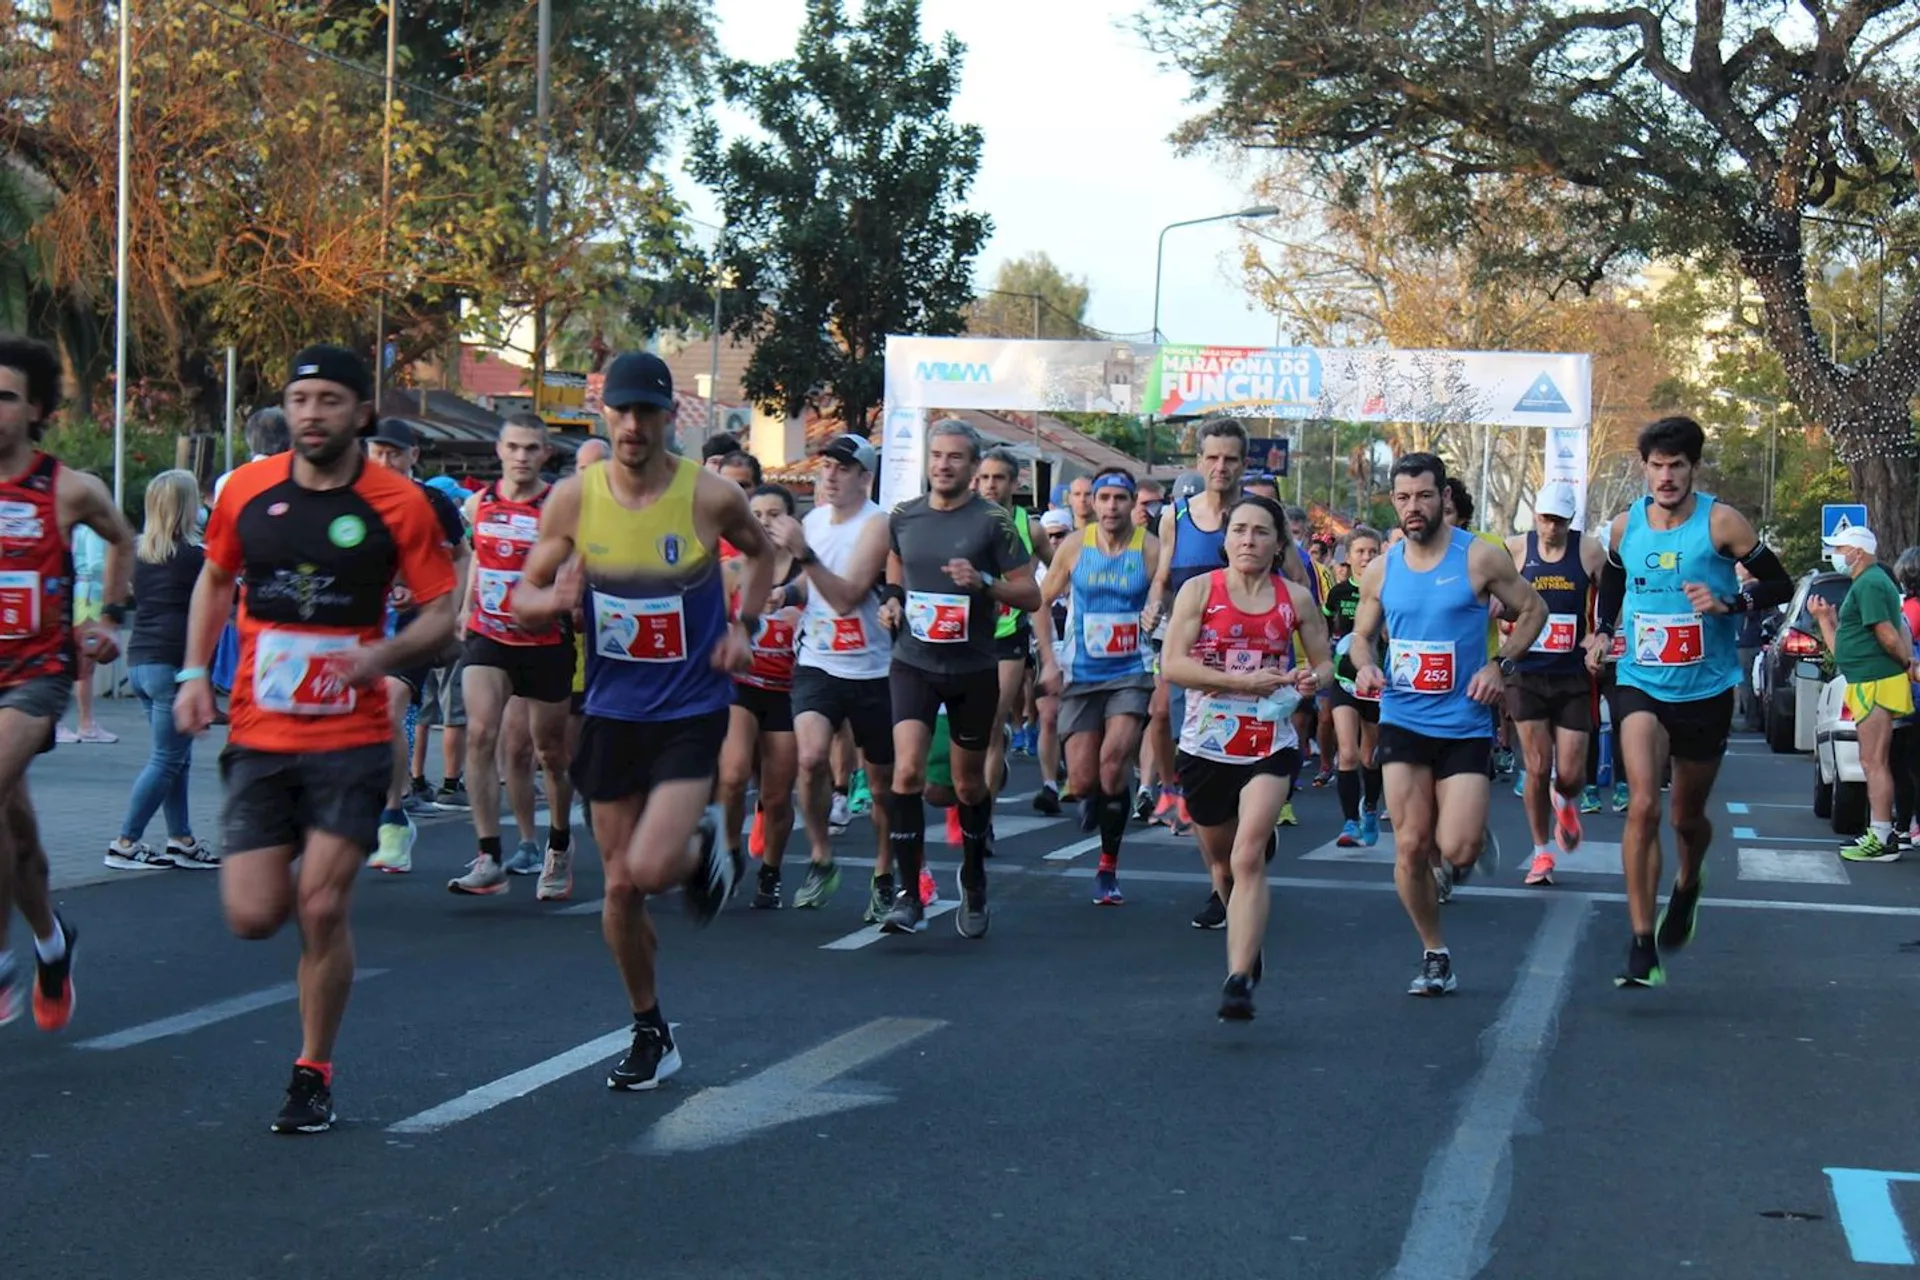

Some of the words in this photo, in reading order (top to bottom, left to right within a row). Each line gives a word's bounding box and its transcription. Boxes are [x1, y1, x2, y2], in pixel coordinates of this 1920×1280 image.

[1163, 355, 1275, 375] MARATONA
[1278, 359, 1310, 375] DO
[1162, 372, 1317, 403] FUNCHAL
[653, 633, 666, 649] 2
[1679, 642, 1689, 653] 4
[1423, 669, 1448, 682] 252
[1249, 734, 1257, 747] 1
